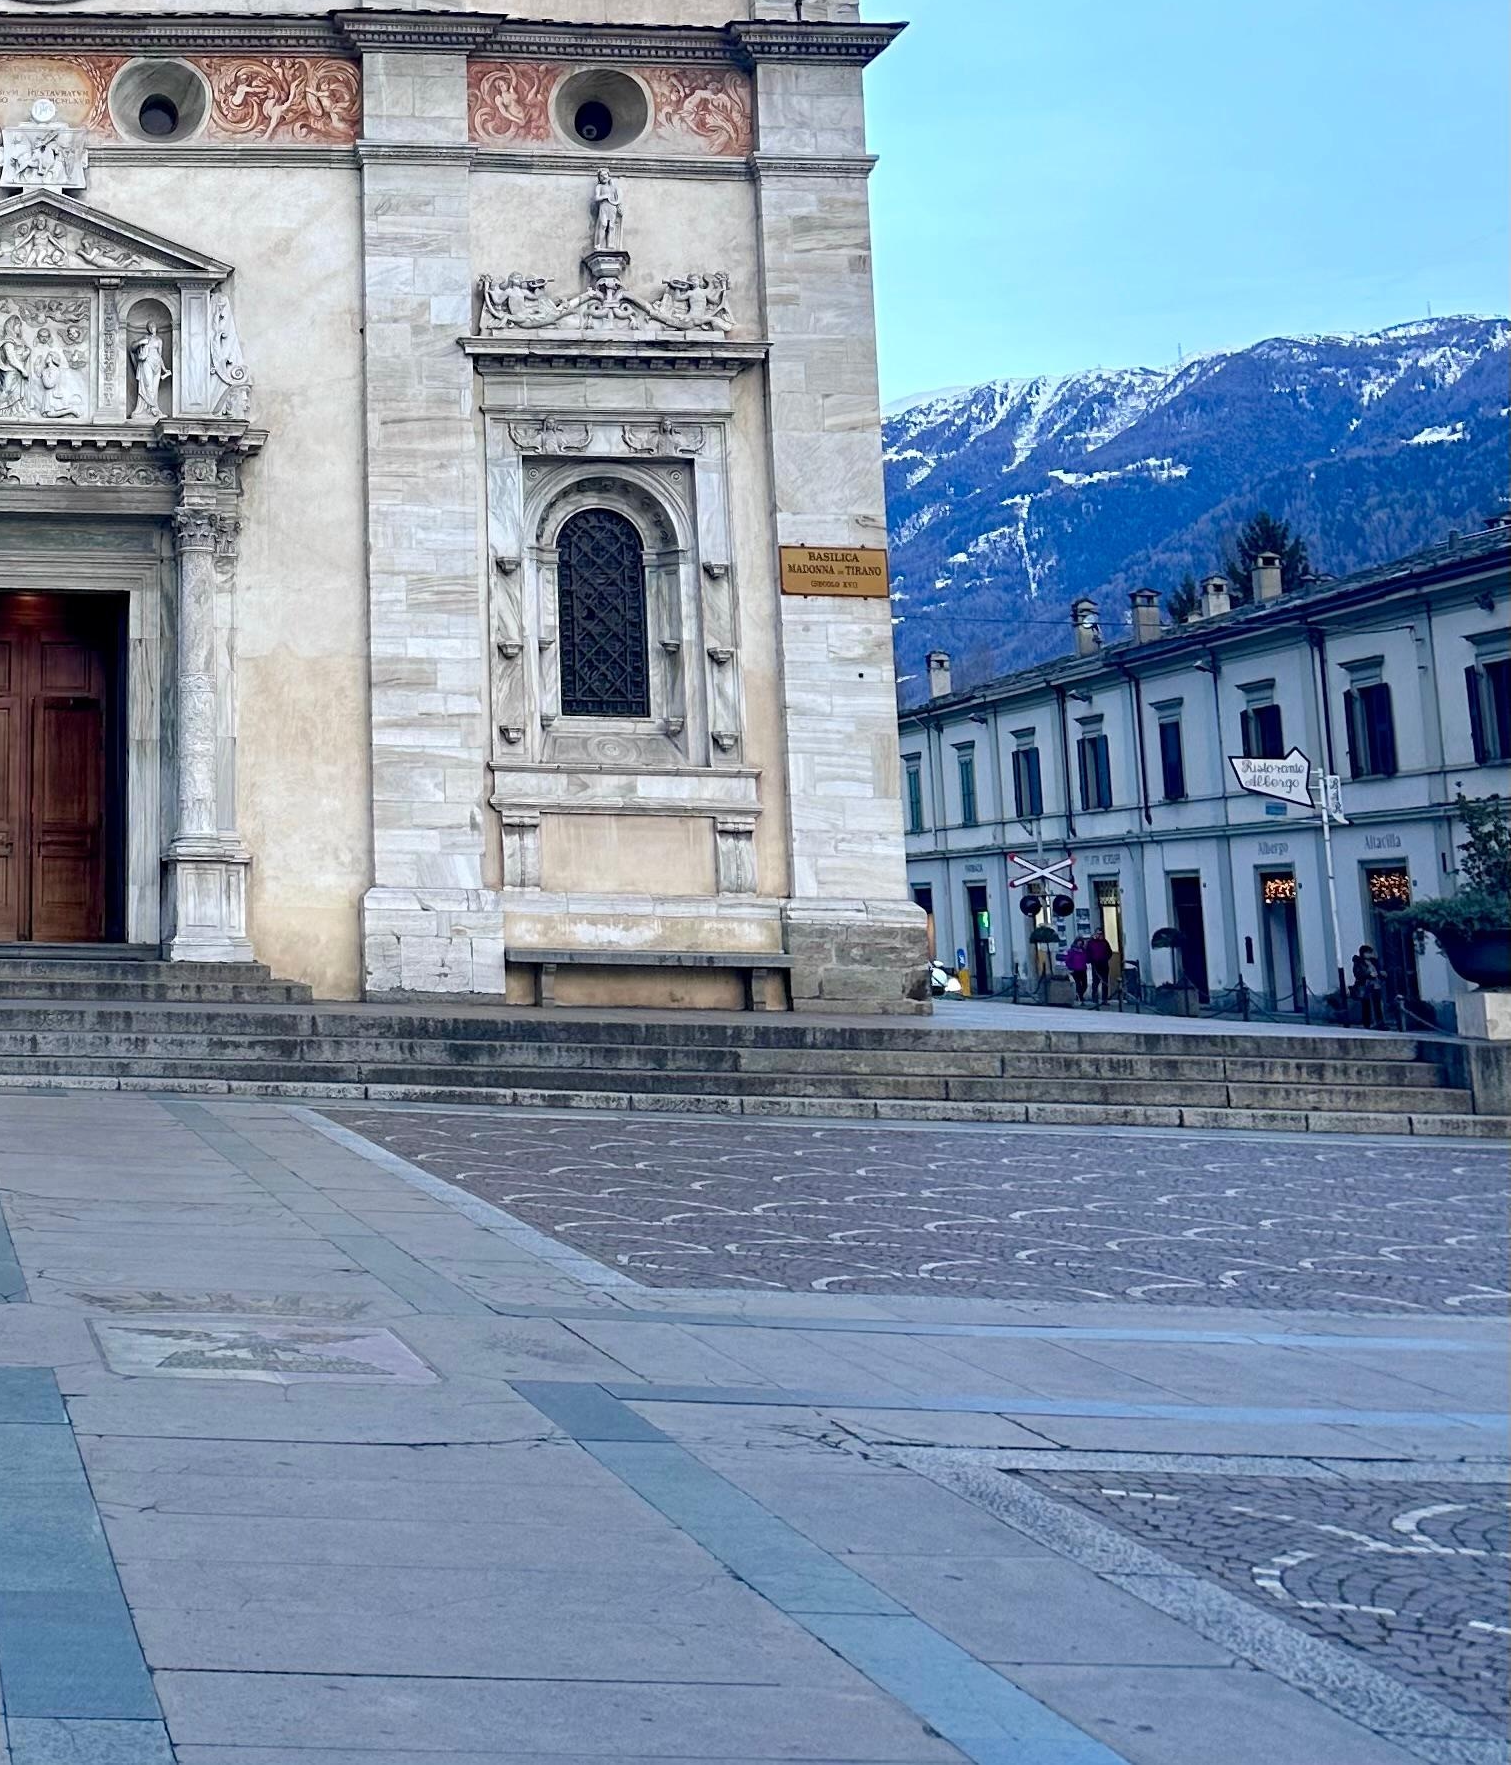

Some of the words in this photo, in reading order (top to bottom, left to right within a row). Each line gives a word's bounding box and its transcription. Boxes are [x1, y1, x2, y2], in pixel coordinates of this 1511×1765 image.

[808, 551, 860, 562] BASILICA
[787, 563, 835, 575] MADONNA
[845, 565, 882, 576] TIRANO
[1241, 759, 1305, 774] Ristorante
[1244, 774, 1300, 793] Albergo
[1257, 841, 1289, 855] Albergo
